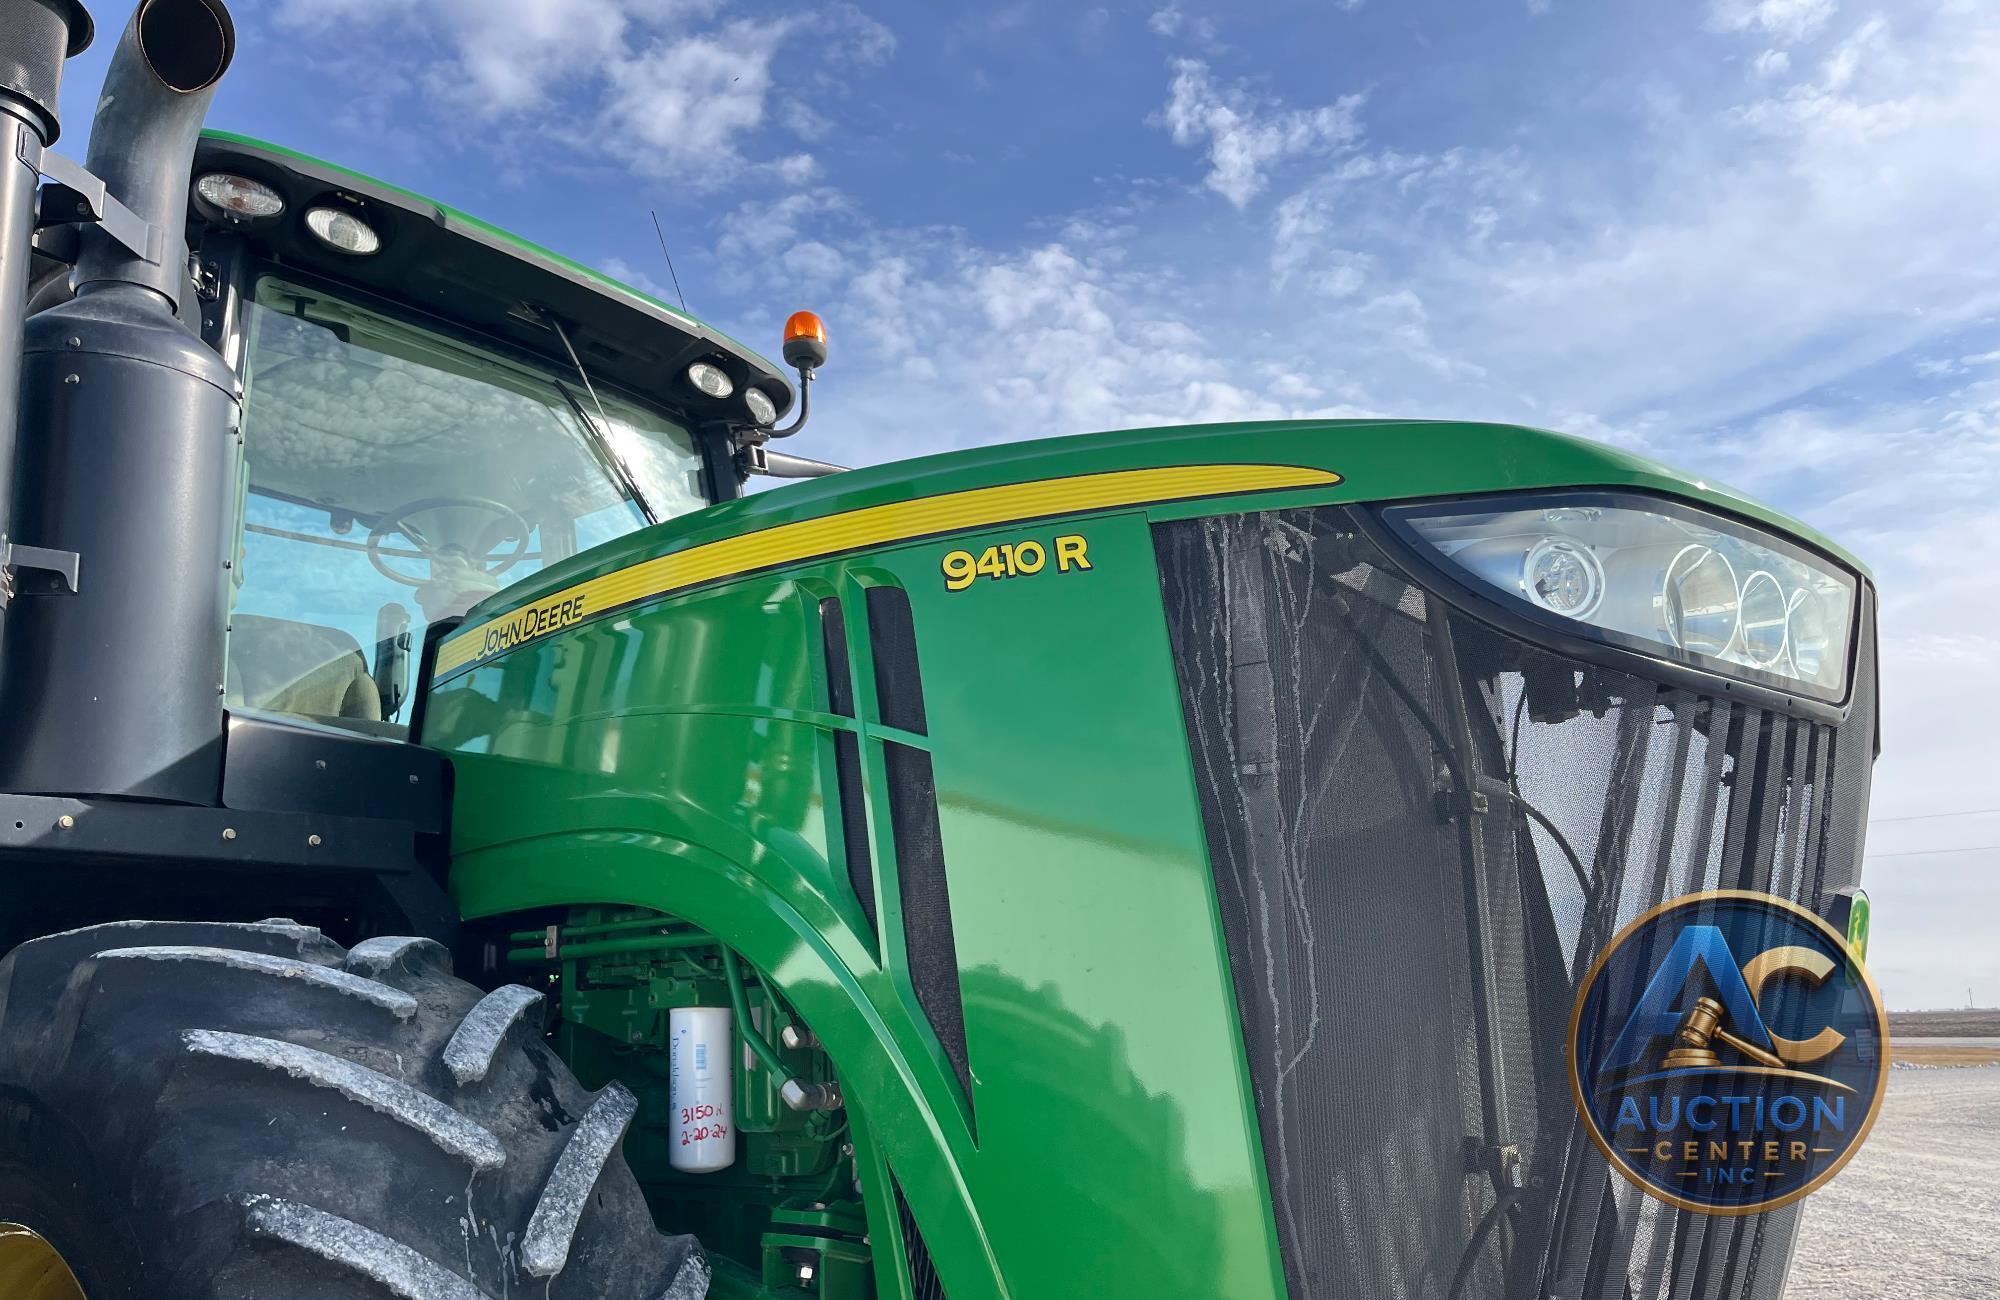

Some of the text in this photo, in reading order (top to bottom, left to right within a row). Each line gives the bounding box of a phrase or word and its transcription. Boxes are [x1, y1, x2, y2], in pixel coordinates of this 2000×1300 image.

[940, 534, 1094, 592] 9410 R
[476, 594, 586, 658] JOHN DEERE
[681, 1104, 714, 1125] 3150
[681, 1123, 728, 1146] 2-20-24
